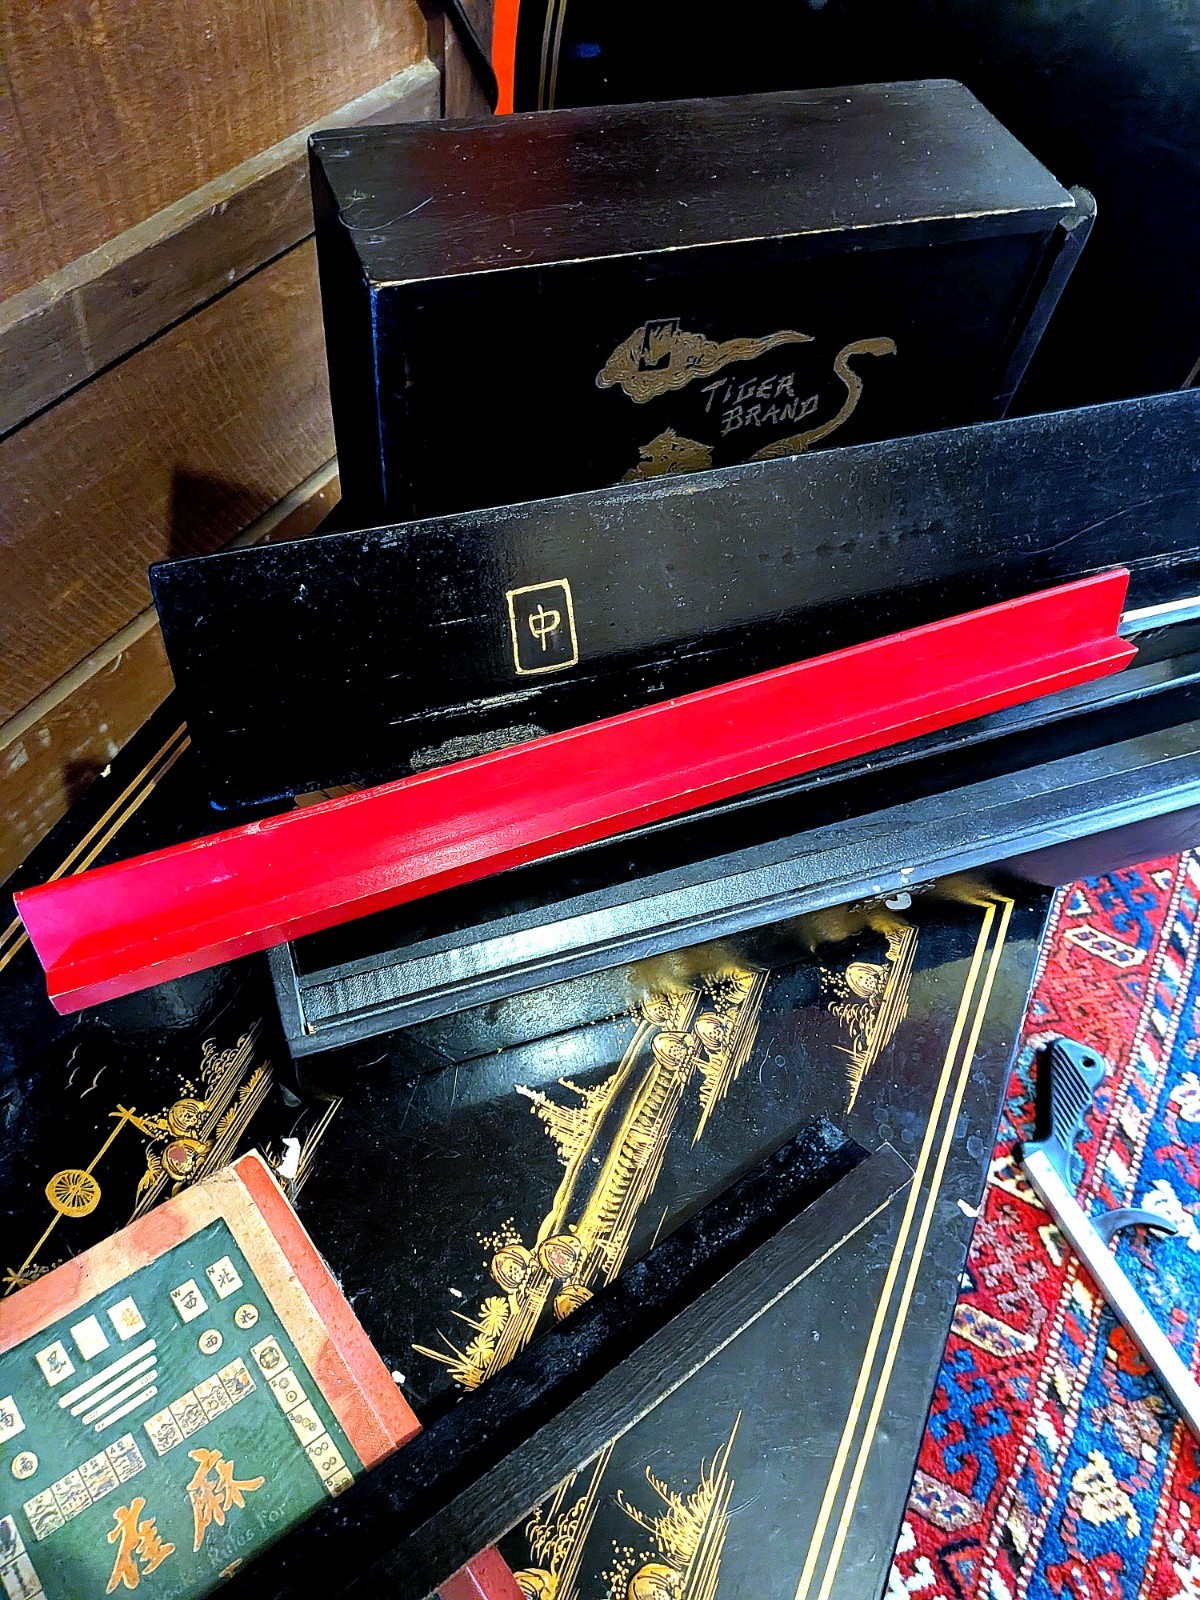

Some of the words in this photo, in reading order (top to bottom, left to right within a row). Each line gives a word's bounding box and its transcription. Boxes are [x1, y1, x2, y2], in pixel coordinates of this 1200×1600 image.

[720, 393, 819, 437] BRAND
[528, 604, 561, 651] 中
[217, 1267, 235, 1288] 北
[180, 1290, 197, 1309] 西
